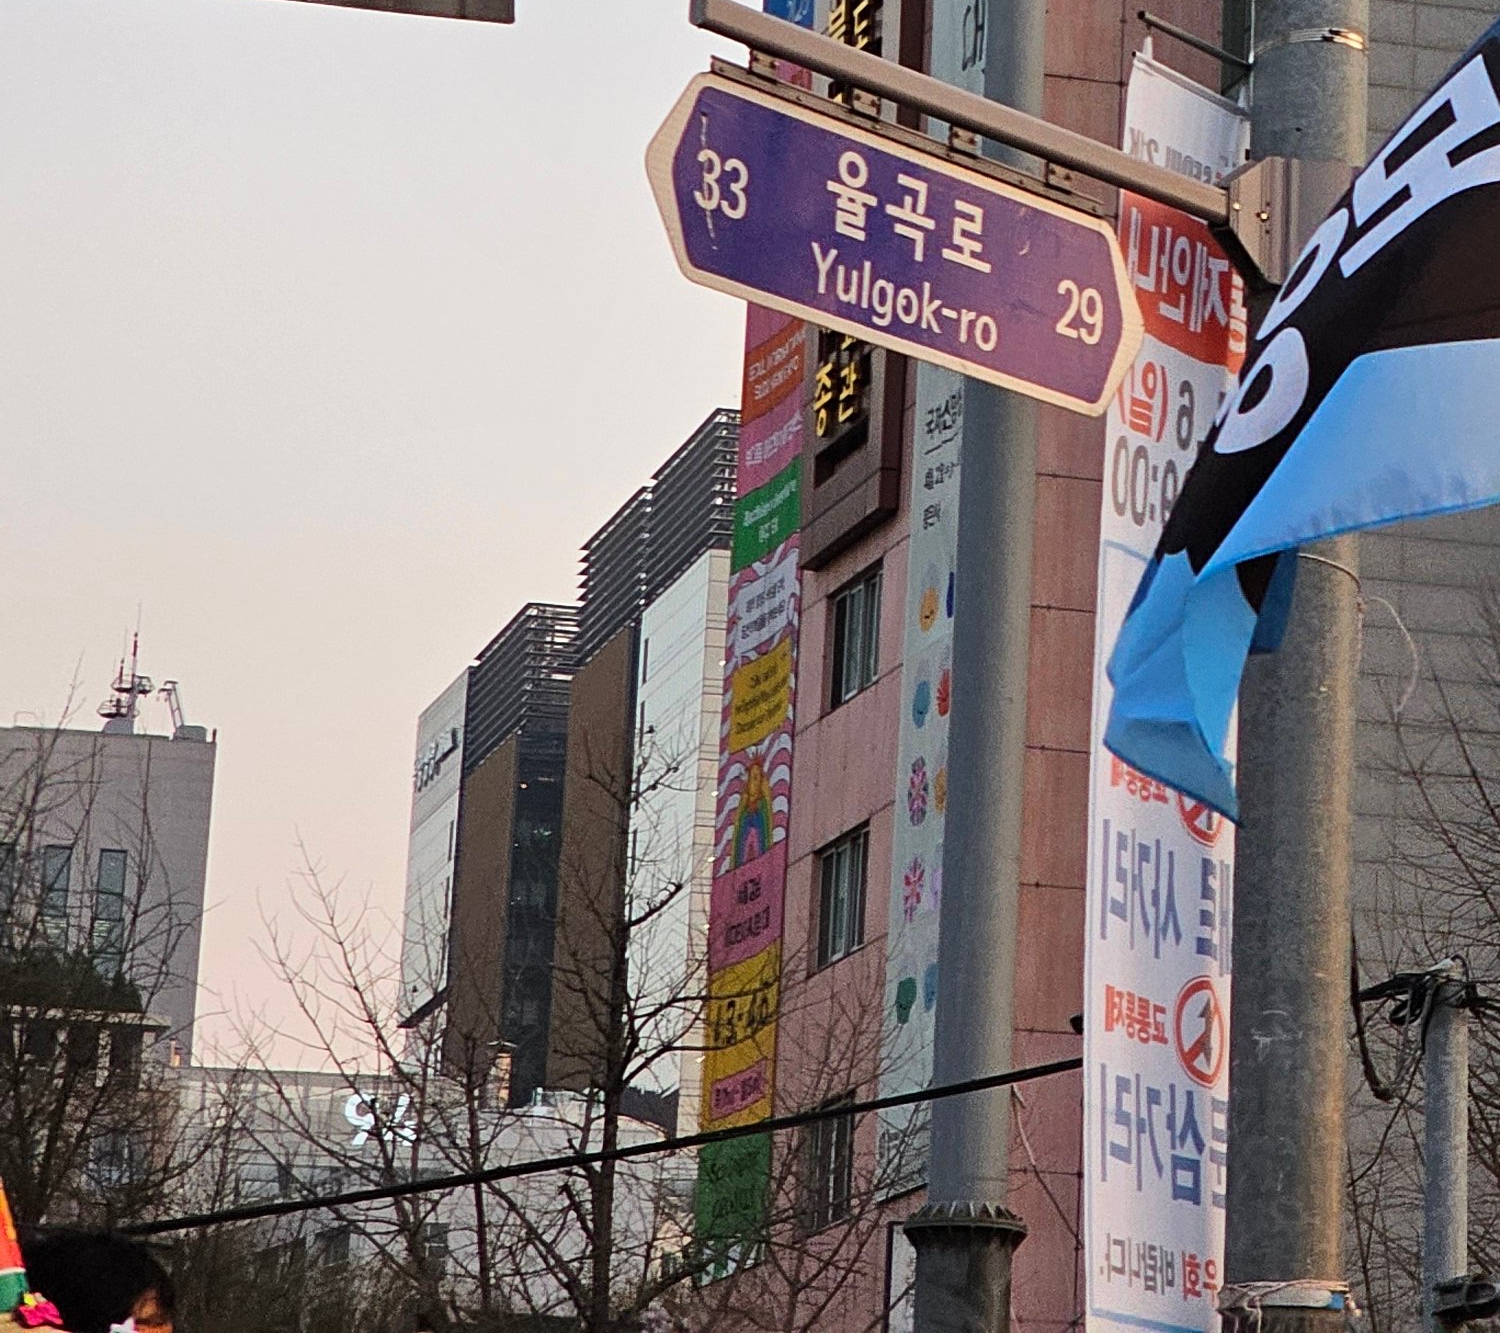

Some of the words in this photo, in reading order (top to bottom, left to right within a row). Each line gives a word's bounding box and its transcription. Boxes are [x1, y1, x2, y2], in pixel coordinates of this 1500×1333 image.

[692, 149, 750, 222] 33
[825, 150, 994, 274] 율곡로
[810, 241, 999, 353] Yulgok-ro
[1055, 277, 1105, 346] 29
